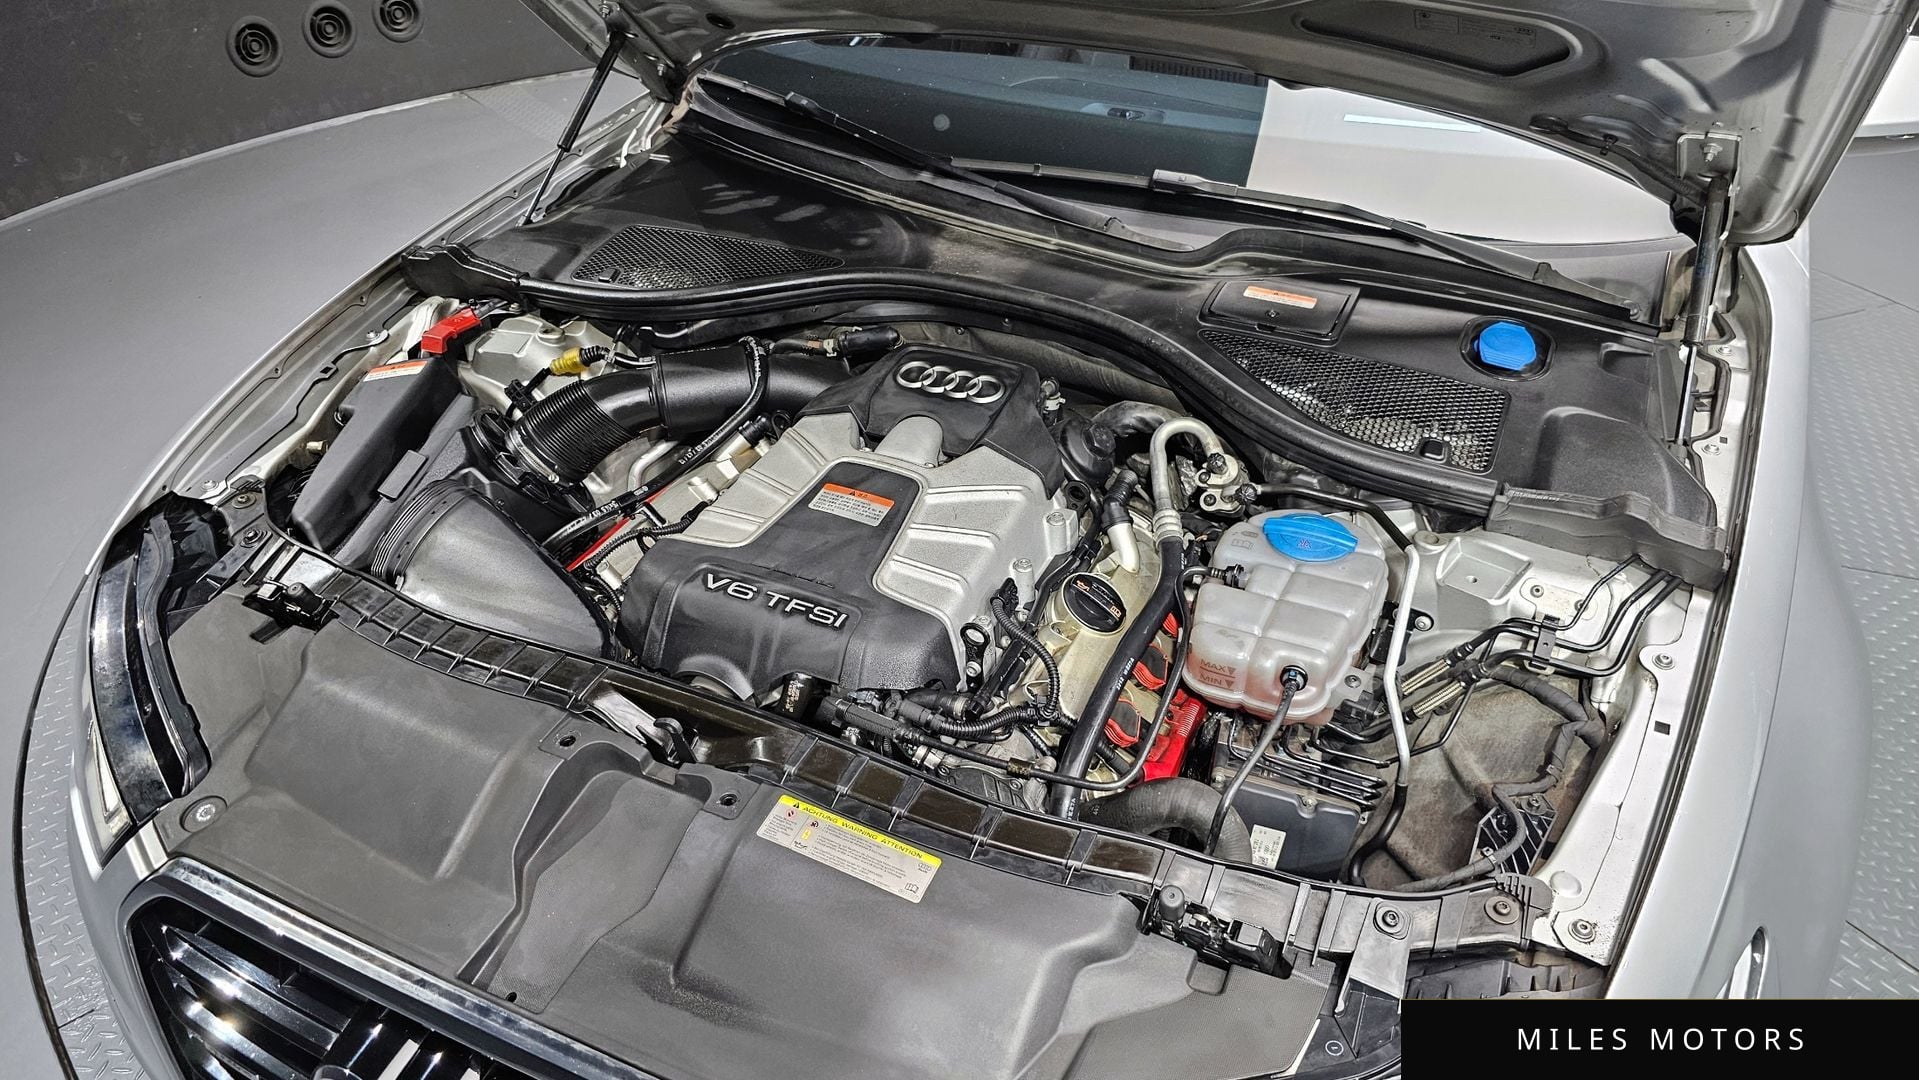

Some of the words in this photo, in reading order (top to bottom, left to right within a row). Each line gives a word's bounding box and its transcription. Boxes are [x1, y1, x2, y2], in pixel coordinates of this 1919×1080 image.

[707, 573, 758, 600] V6
[766, 590, 848, 628] TFSI
[1200, 659, 1226, 672] MAX
[1200, 673, 1222, 685] MIN
[803, 806, 838, 824] ACHTUNG
[841, 822, 879, 840] WARNING
[880, 838, 923, 859] ATTENTION
